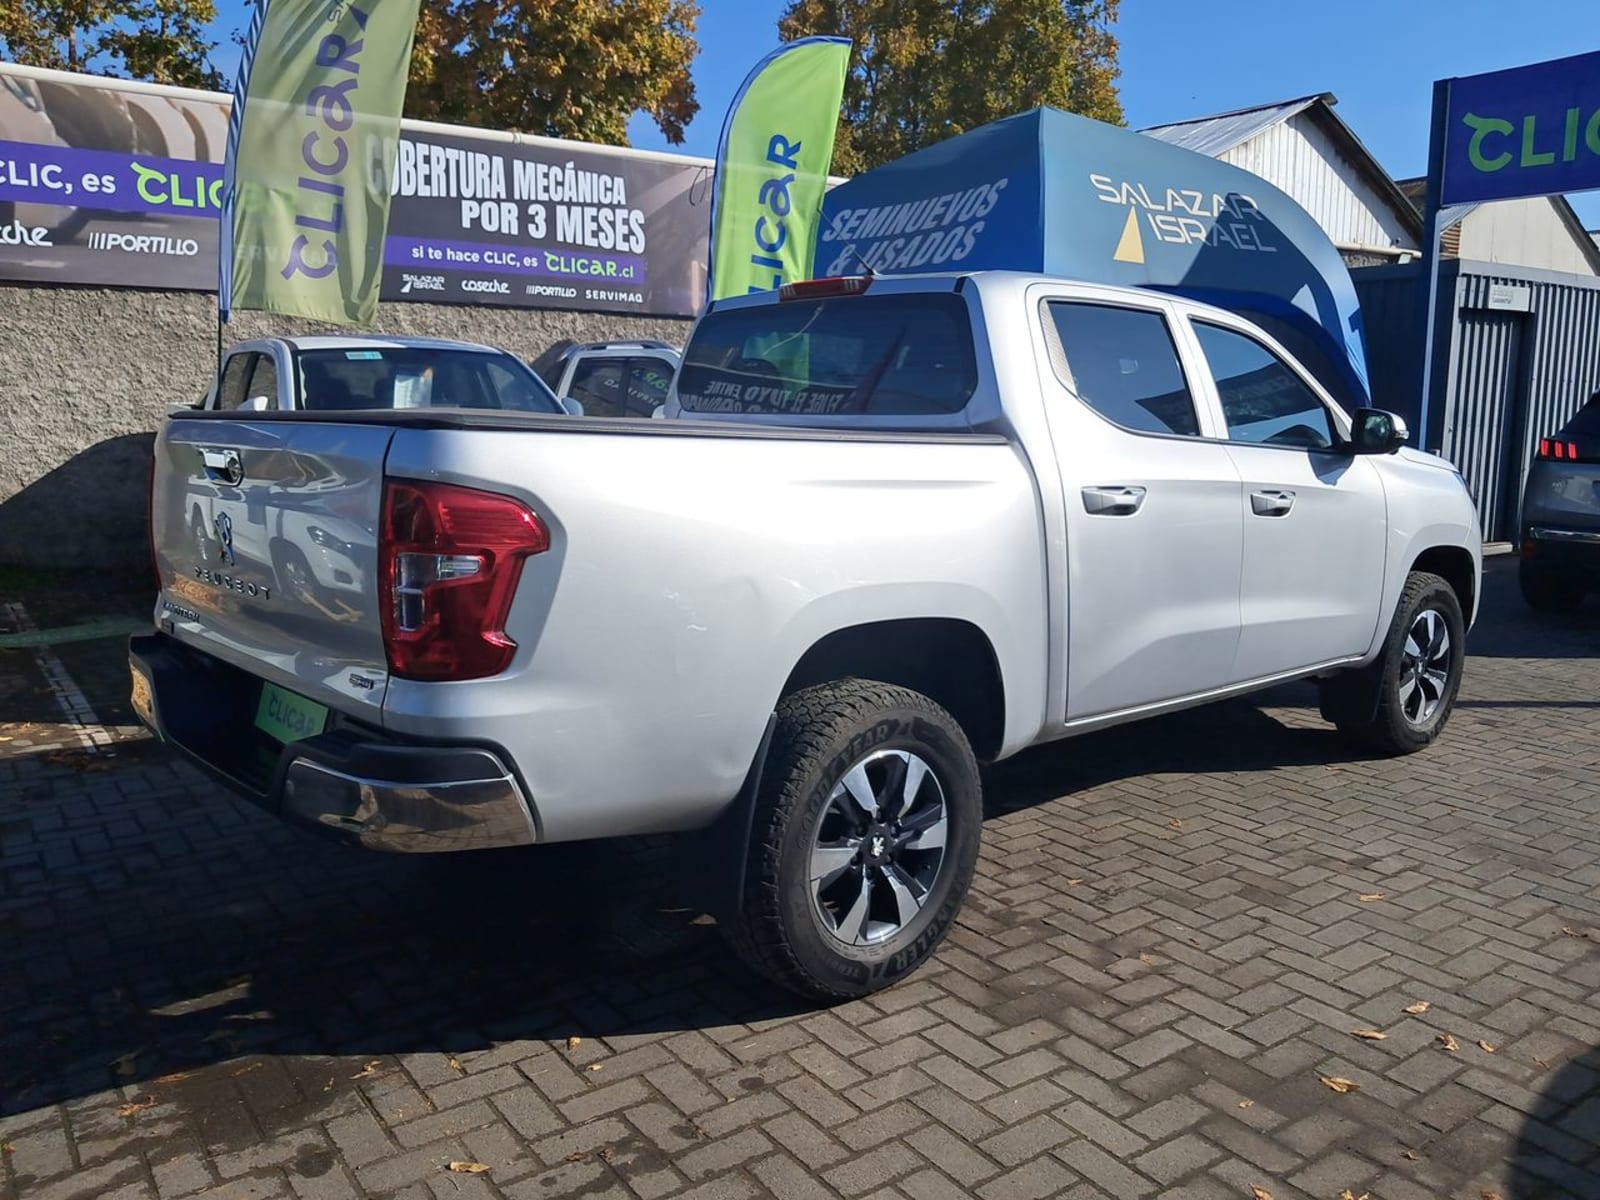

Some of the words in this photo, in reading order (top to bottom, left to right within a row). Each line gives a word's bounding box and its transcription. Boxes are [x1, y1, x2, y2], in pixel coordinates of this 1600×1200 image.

[0, 160, 72, 194] LIC,
[81, 172, 116, 193] es
[513, 159, 626, 205] MECÁNICA
[822, 178, 1008, 241] SEMINUEVOS
[1089, 173, 1263, 221] SALAZAR
[106, 232, 199, 256] PORTILLO
[461, 200, 519, 235] POR
[527, 203, 547, 239] 3
[556, 204, 646, 254] MESES
[1147, 213, 1277, 252] ISRAEL
[411, 245, 424, 258] si
[428, 247, 443, 259] te
[447, 247, 480, 263] hace
[483, 251, 521, 268] CLIC,
[523, 256, 539, 268] es
[826, 243, 856, 276] &
[856, 221, 985, 273] USADOS
[402, 273, 445, 284] SALAZAR
[534, 284, 577, 298] PORTILLO
[585, 288, 643, 304] SERVIMAQ
[193, 565, 272, 600] PEUGEOT
